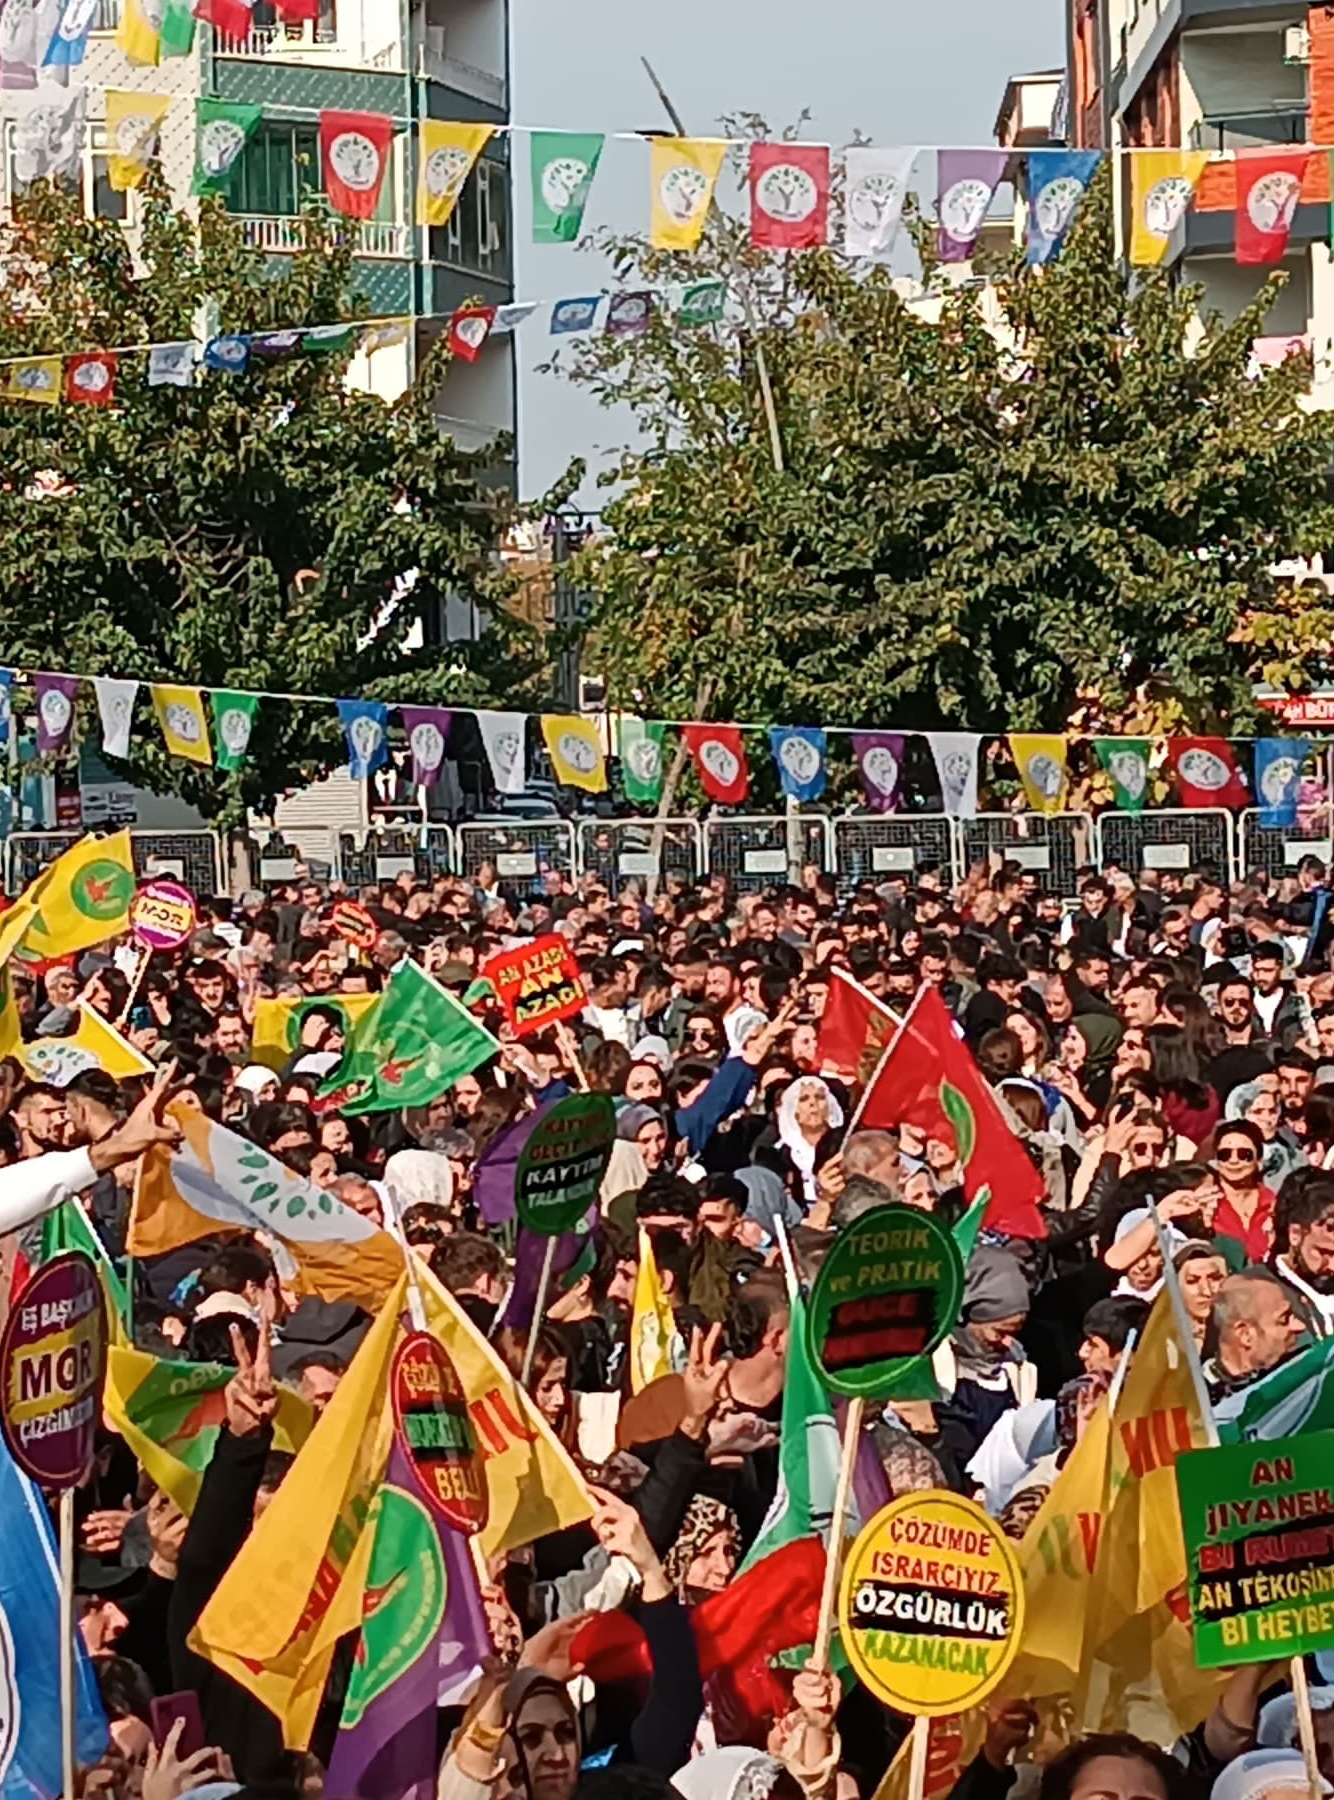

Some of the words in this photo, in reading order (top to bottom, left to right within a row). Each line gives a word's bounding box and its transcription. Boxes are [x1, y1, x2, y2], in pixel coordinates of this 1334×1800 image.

[519, 965, 564, 998] AN
[848, 1227, 930, 1257] TEORİK
[857, 1257, 943, 1287] PRATİK
[19, 1338, 93, 1403] MOR
[1252, 1457, 1294, 1486] AN
[889, 1514, 994, 1558] ÇÖZÜMDE
[1199, 1545, 1234, 1572] BI
[855, 1582, 1009, 1637] ÖZGÜRLÜK
[1198, 1581, 1233, 1611] AN
[1222, 1616, 1249, 1646] BI
[864, 1628, 990, 1678] KAZANACAK
